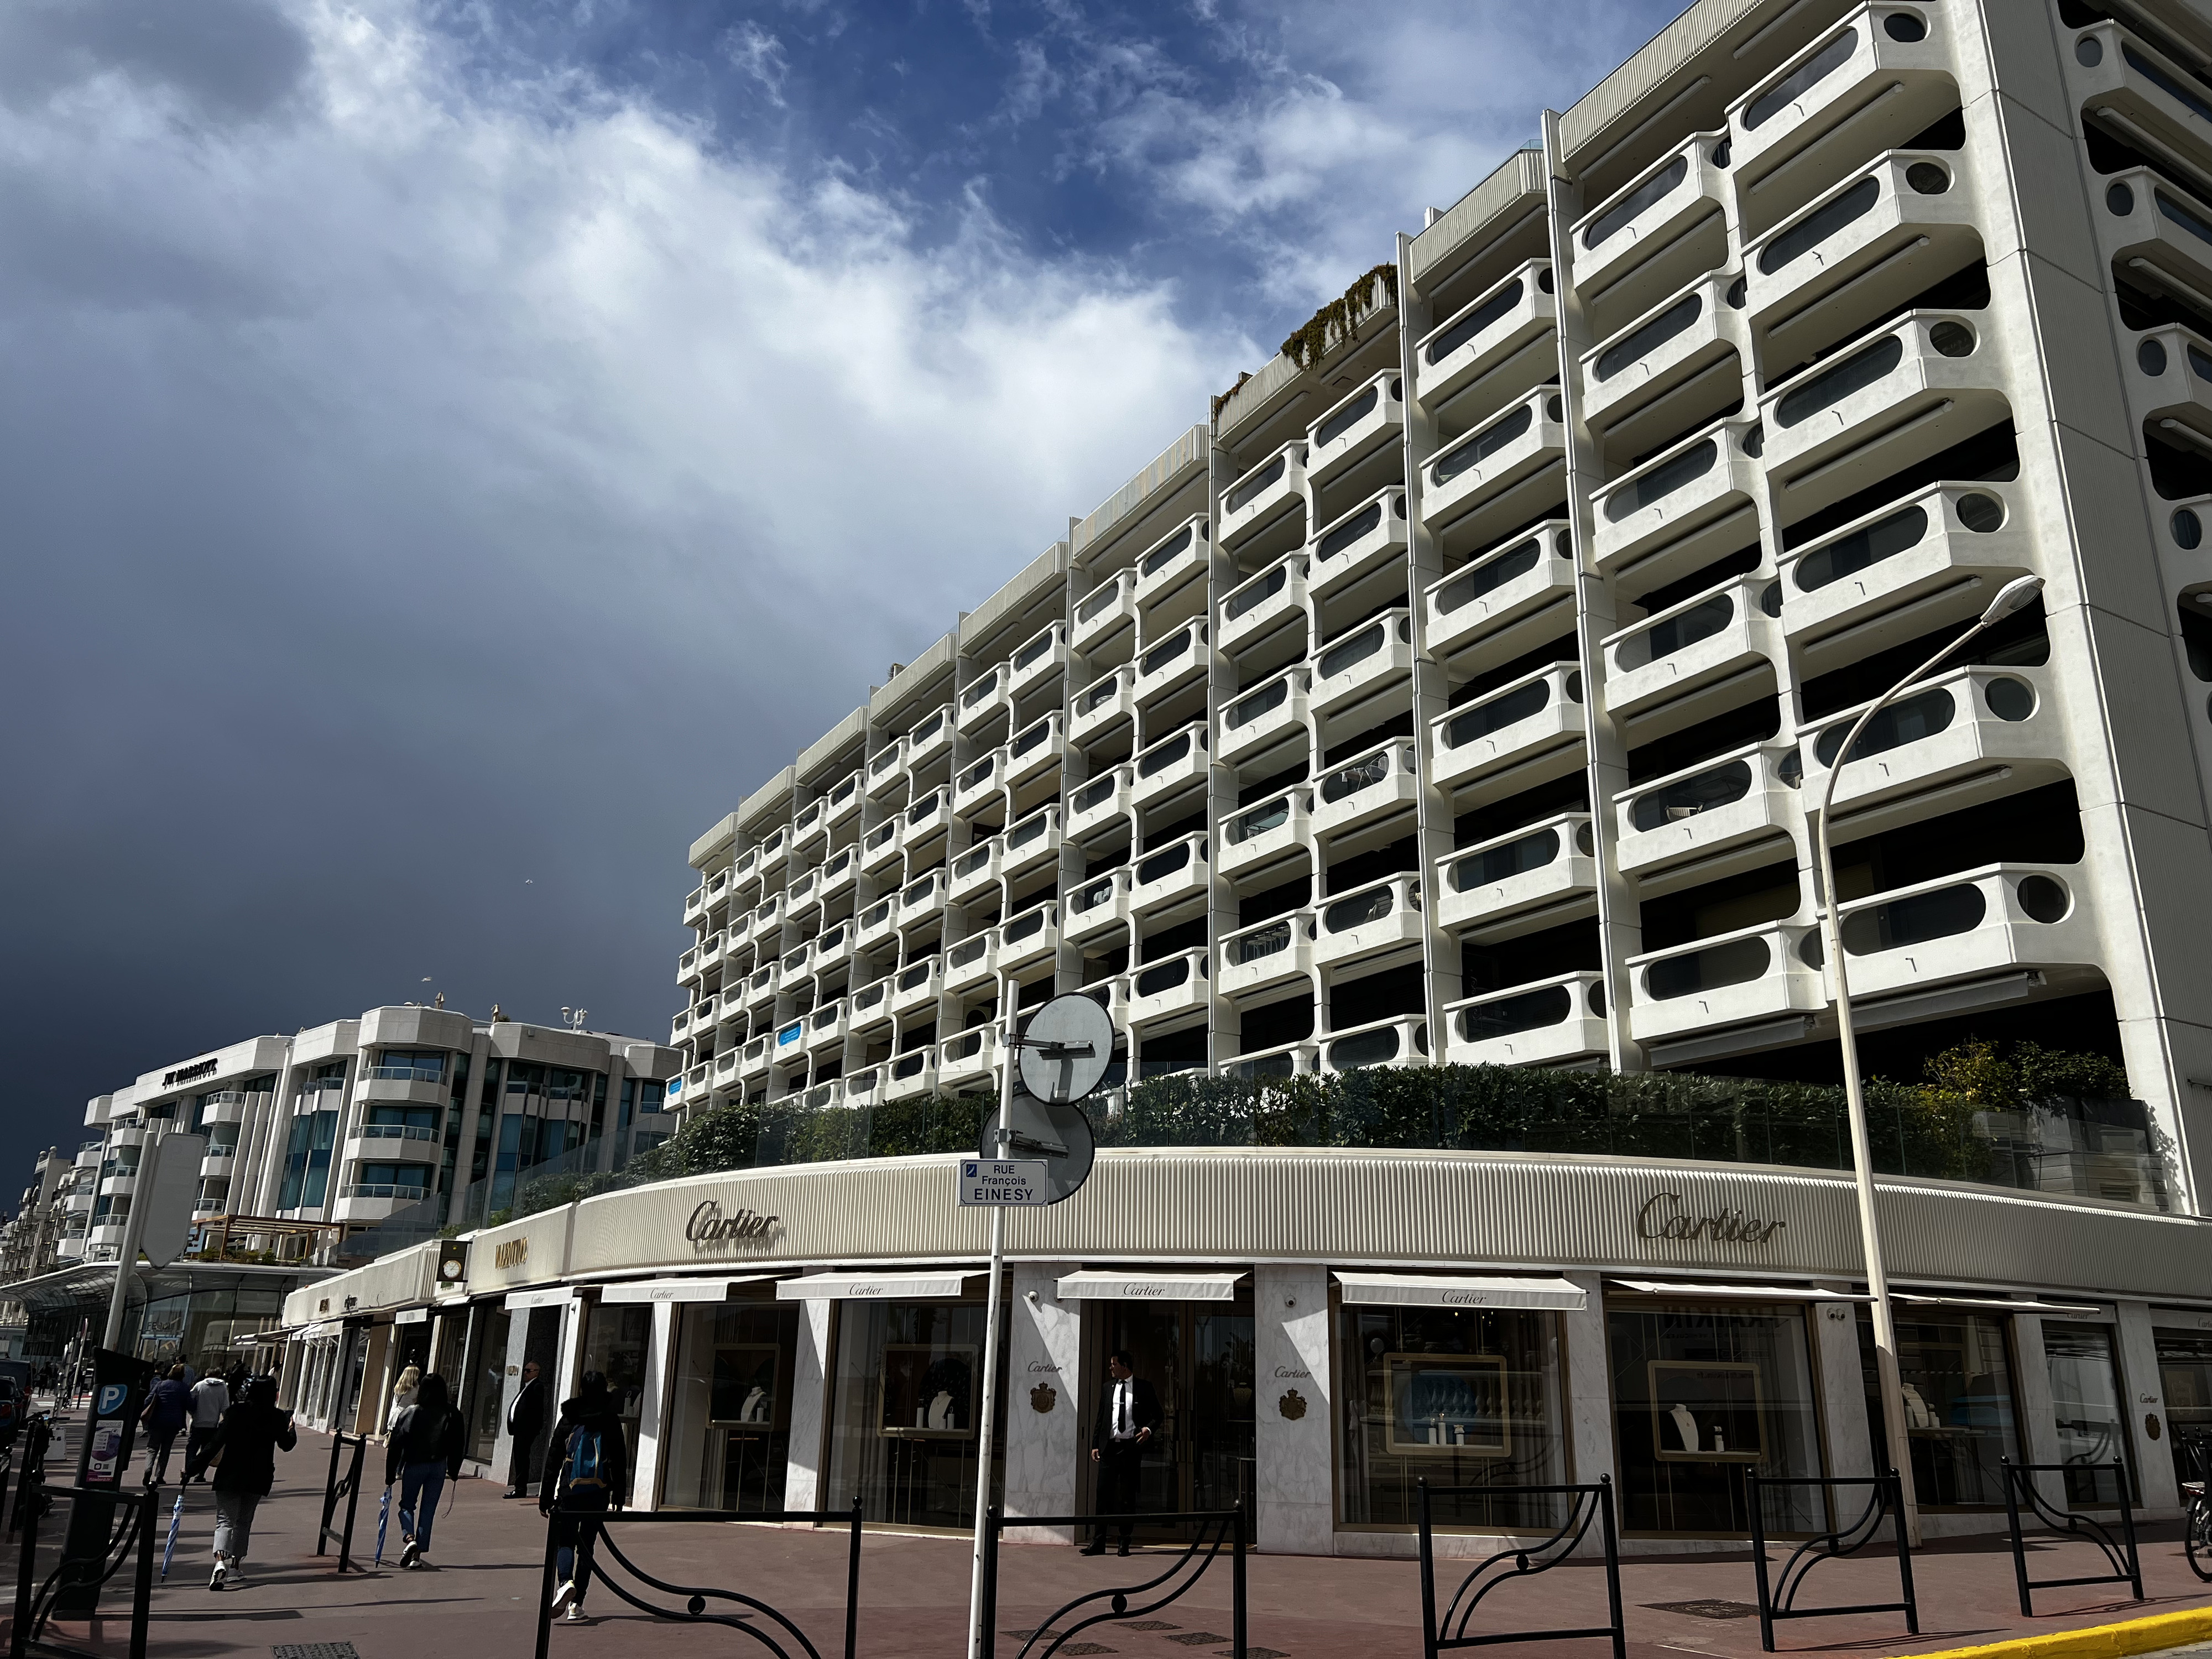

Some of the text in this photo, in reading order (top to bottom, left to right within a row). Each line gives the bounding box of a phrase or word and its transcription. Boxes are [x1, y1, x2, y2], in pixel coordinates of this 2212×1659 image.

[162, 1058, 218, 1087] JW MARRIOTT
[994, 1165, 1015, 1174] RUE
[982, 1176, 1026, 1187] François
[974, 1188, 1033, 1201] EINESY
[686, 1201, 779, 1241] Cartier
[1636, 1192, 1786, 1243] Cartier
[650, 1287, 674, 1299] Cartier
[849, 1283, 883, 1295] Cartier
[1124, 1282, 1165, 1296] Cartier
[531, 1295, 545, 1305] Cartier
[1442, 1290, 1486, 1304] Cartier
[2198, 1317, 2212, 1328] Carti
[1028, 1360, 1062, 1373] Cartier
[1275, 1366, 1311, 1378] Cartier
[102, 1387, 119, 1409] P
[2140, 1393, 2158, 1404] Cartier
